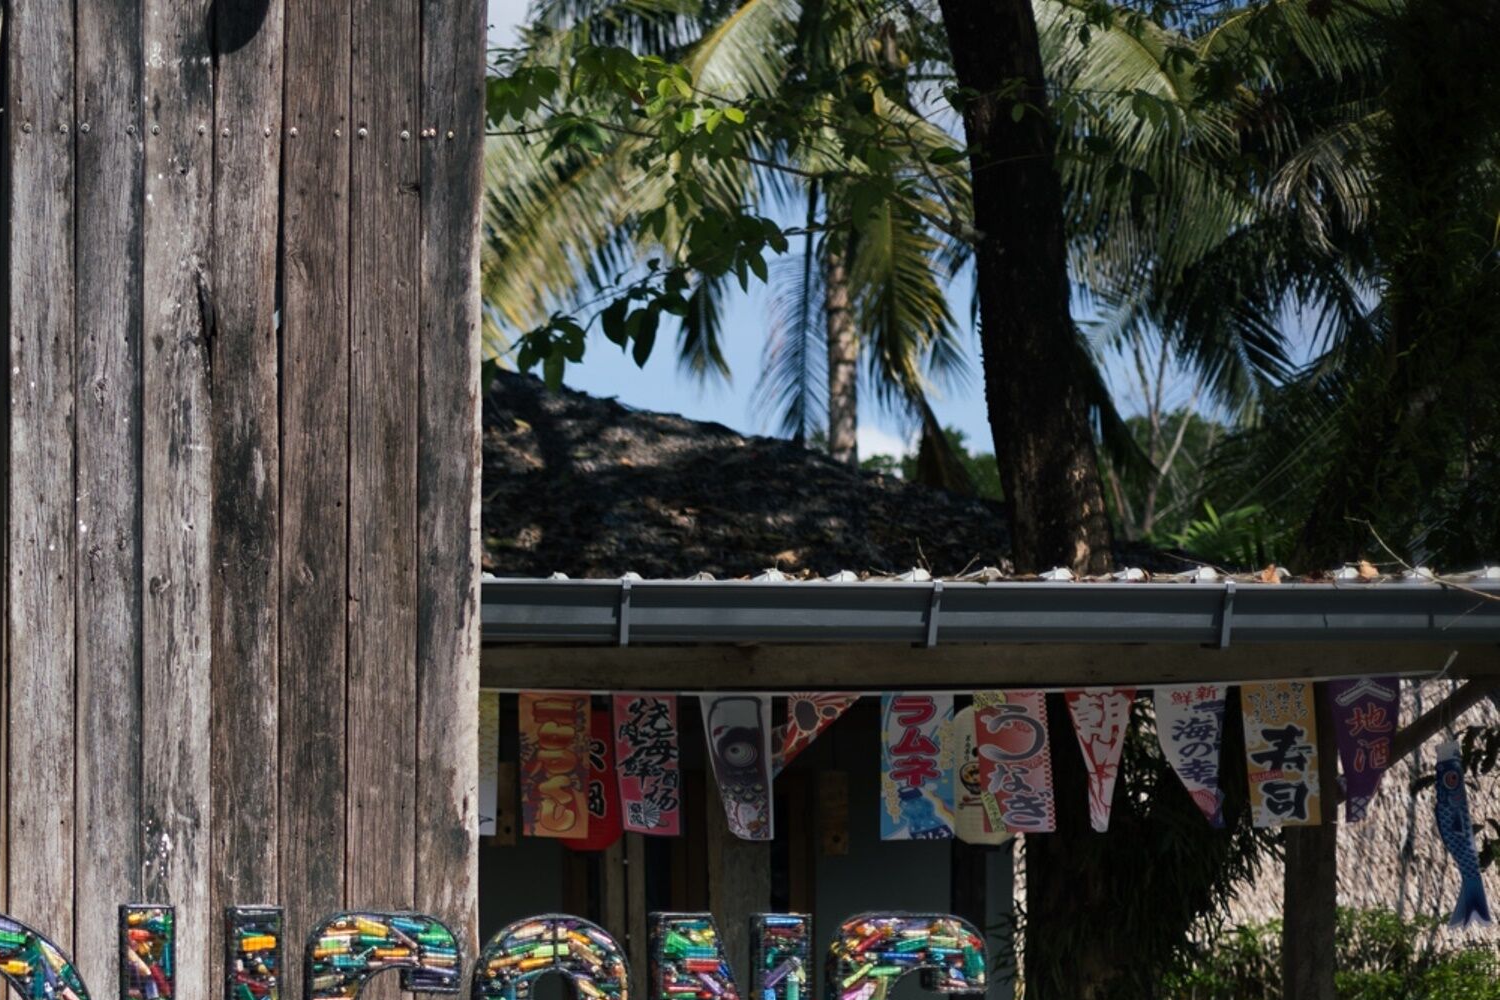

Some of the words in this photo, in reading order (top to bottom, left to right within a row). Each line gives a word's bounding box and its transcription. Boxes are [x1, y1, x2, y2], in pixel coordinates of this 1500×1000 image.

[891, 695, 941, 787] ラムネ
[979, 704, 1051, 827] うなぎ
[1171, 718, 1217, 783] 海の幸
[1252, 724, 1314, 821] 寿司
[1345, 702, 1393, 774] 地酒
